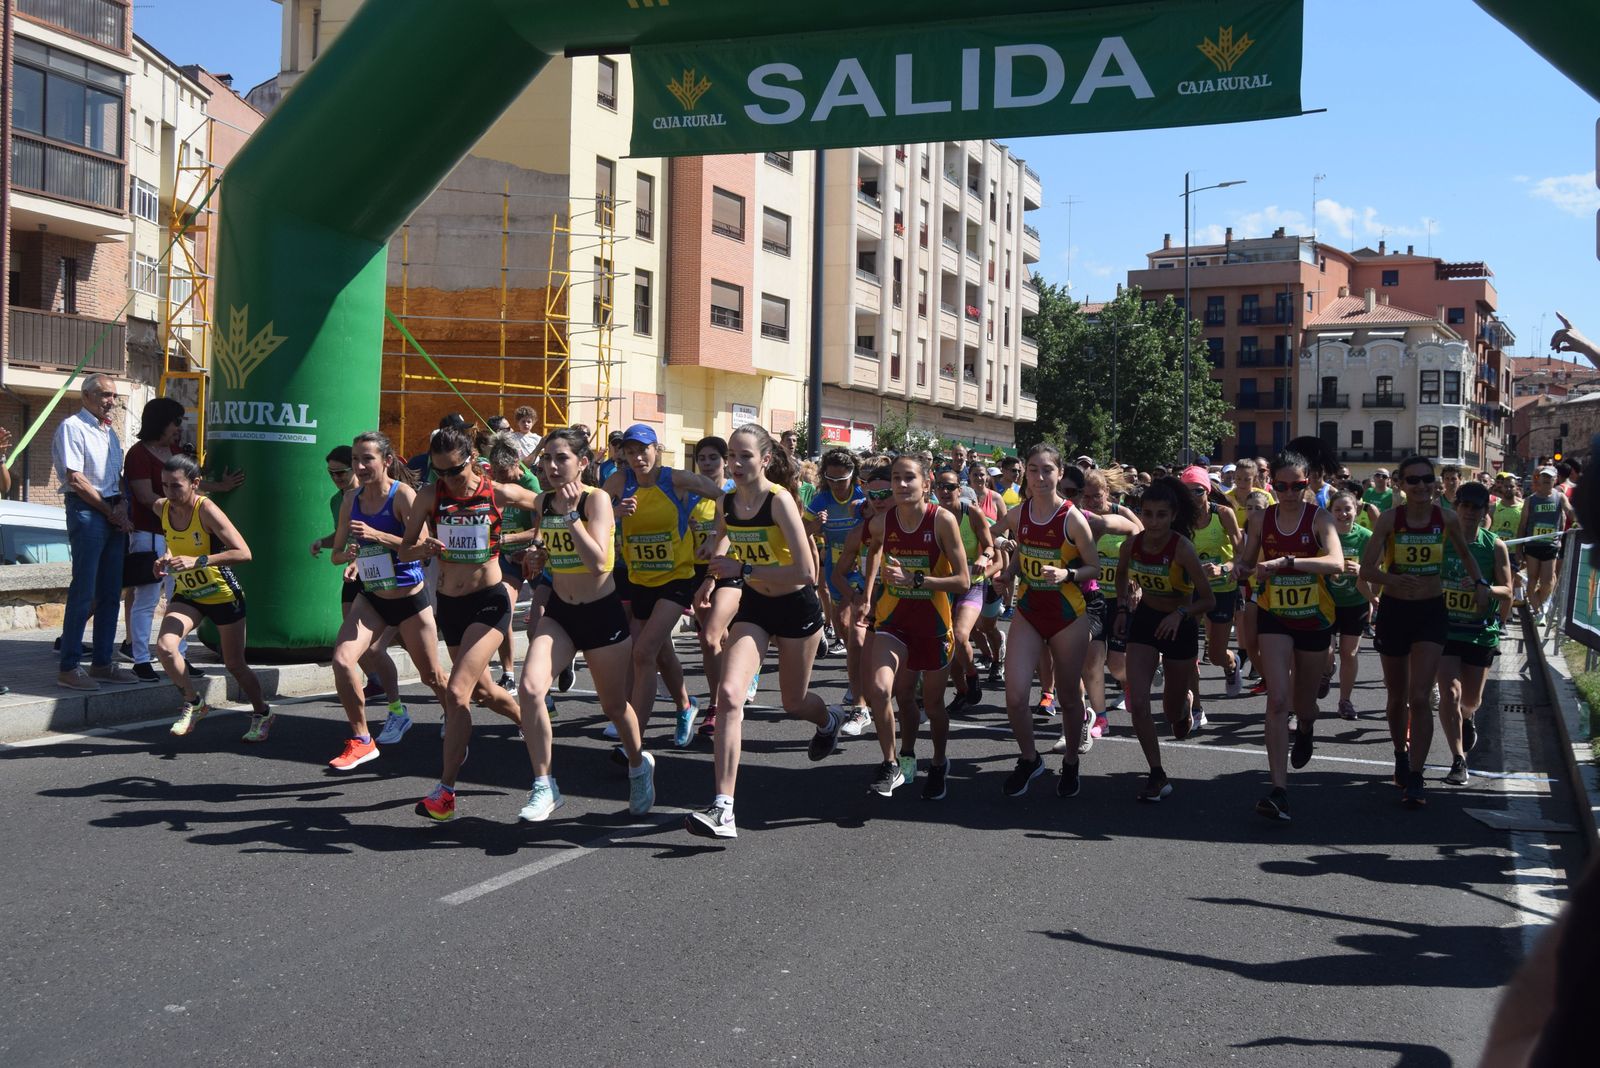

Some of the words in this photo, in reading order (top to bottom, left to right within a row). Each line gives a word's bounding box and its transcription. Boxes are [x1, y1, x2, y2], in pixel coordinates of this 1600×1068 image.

[743, 36, 1156, 125] SALIDA
[1177, 79, 1216, 96] CAJA
[1217, 73, 1273, 92] RURAL
[652, 115, 682, 130] CAJA
[682, 113, 727, 128] RURAL
[278, 434, 308, 442] ZAMORA
[440, 514, 492, 525] KENYA
[449, 536, 477, 548] MARTA
[543, 531, 575, 552] 248
[634, 544, 667, 560] 156
[735, 544, 770, 562] 244
[1406, 546, 1431, 563] 39
[178, 569, 208, 588] 160
[1132, 573, 1165, 590] 136
[1275, 587, 1311, 606] 107
